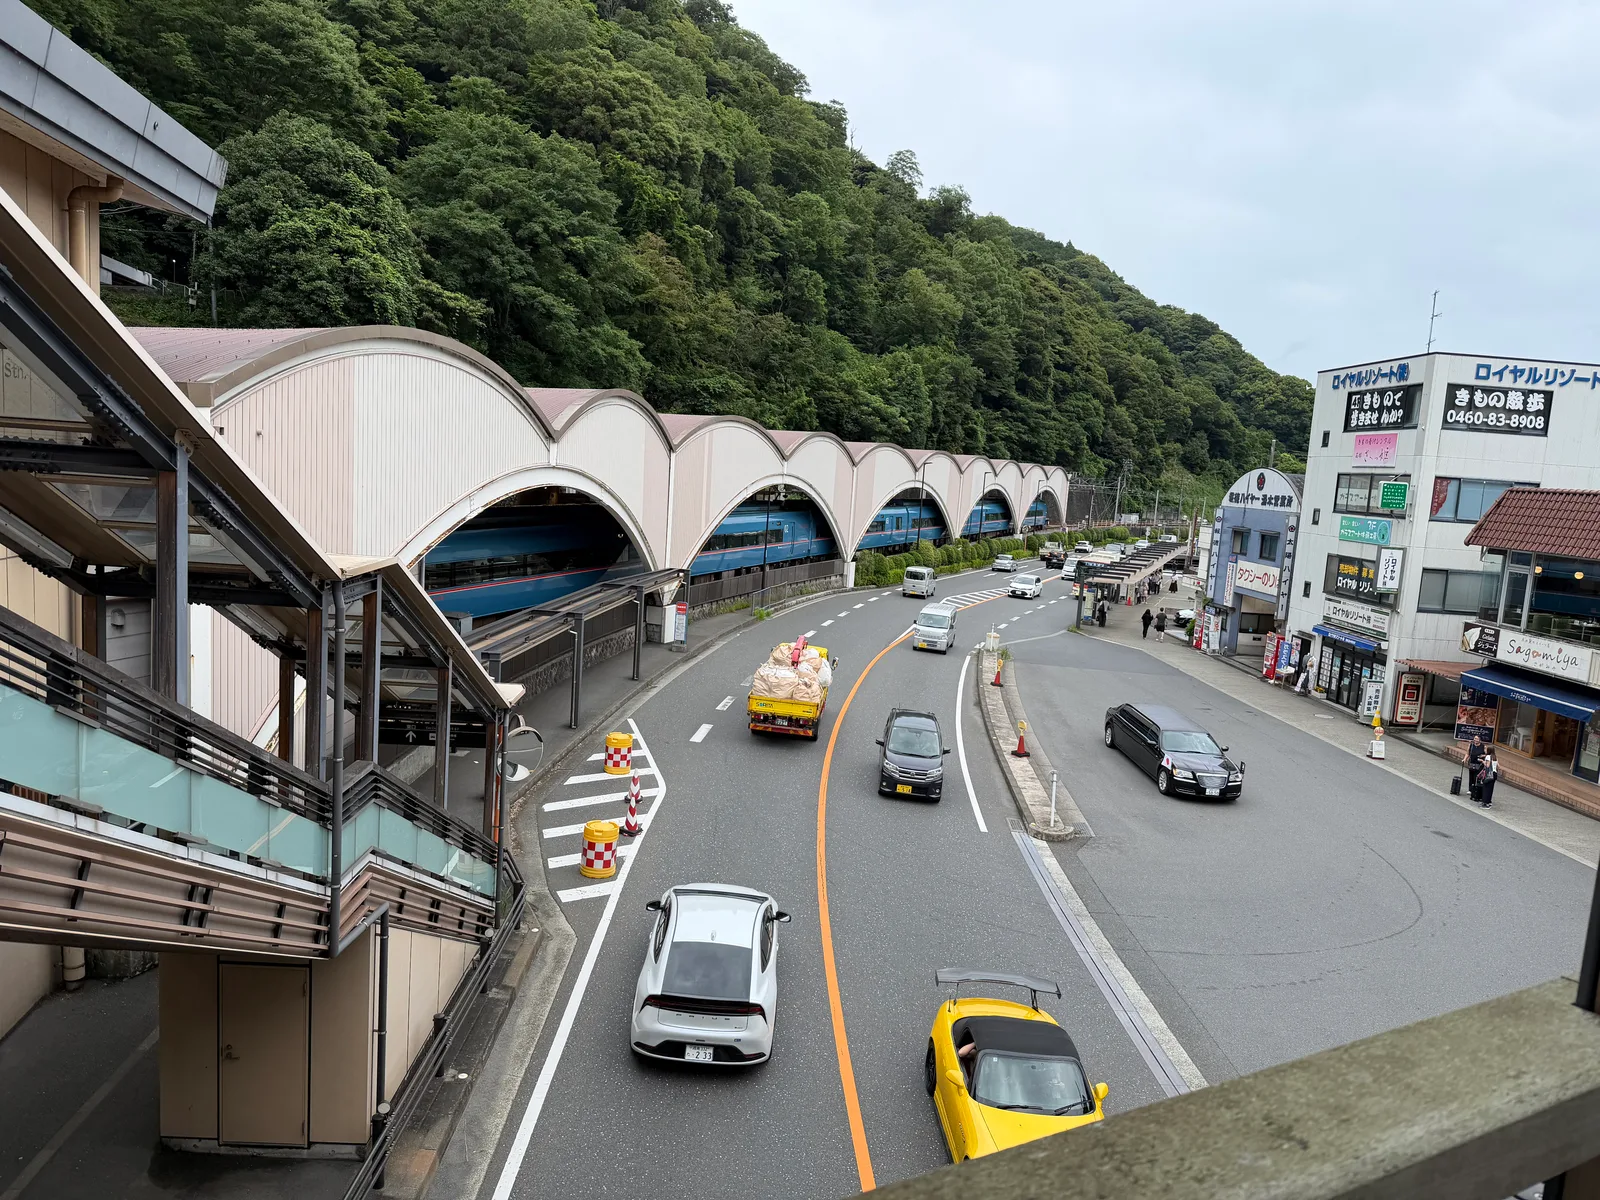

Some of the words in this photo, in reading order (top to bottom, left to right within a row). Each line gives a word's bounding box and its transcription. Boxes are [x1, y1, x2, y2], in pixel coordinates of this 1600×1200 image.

[1474, 363, 1600, 389] ロイヤルリゾート
[1454, 387, 1545, 412] きもの散歩
[1446, 409, 1545, 429] 0460-83-8908
[1280, 539, 1294, 611] 太陽ハイヤー
[1389, 558, 1397, 581] ロイヤル
